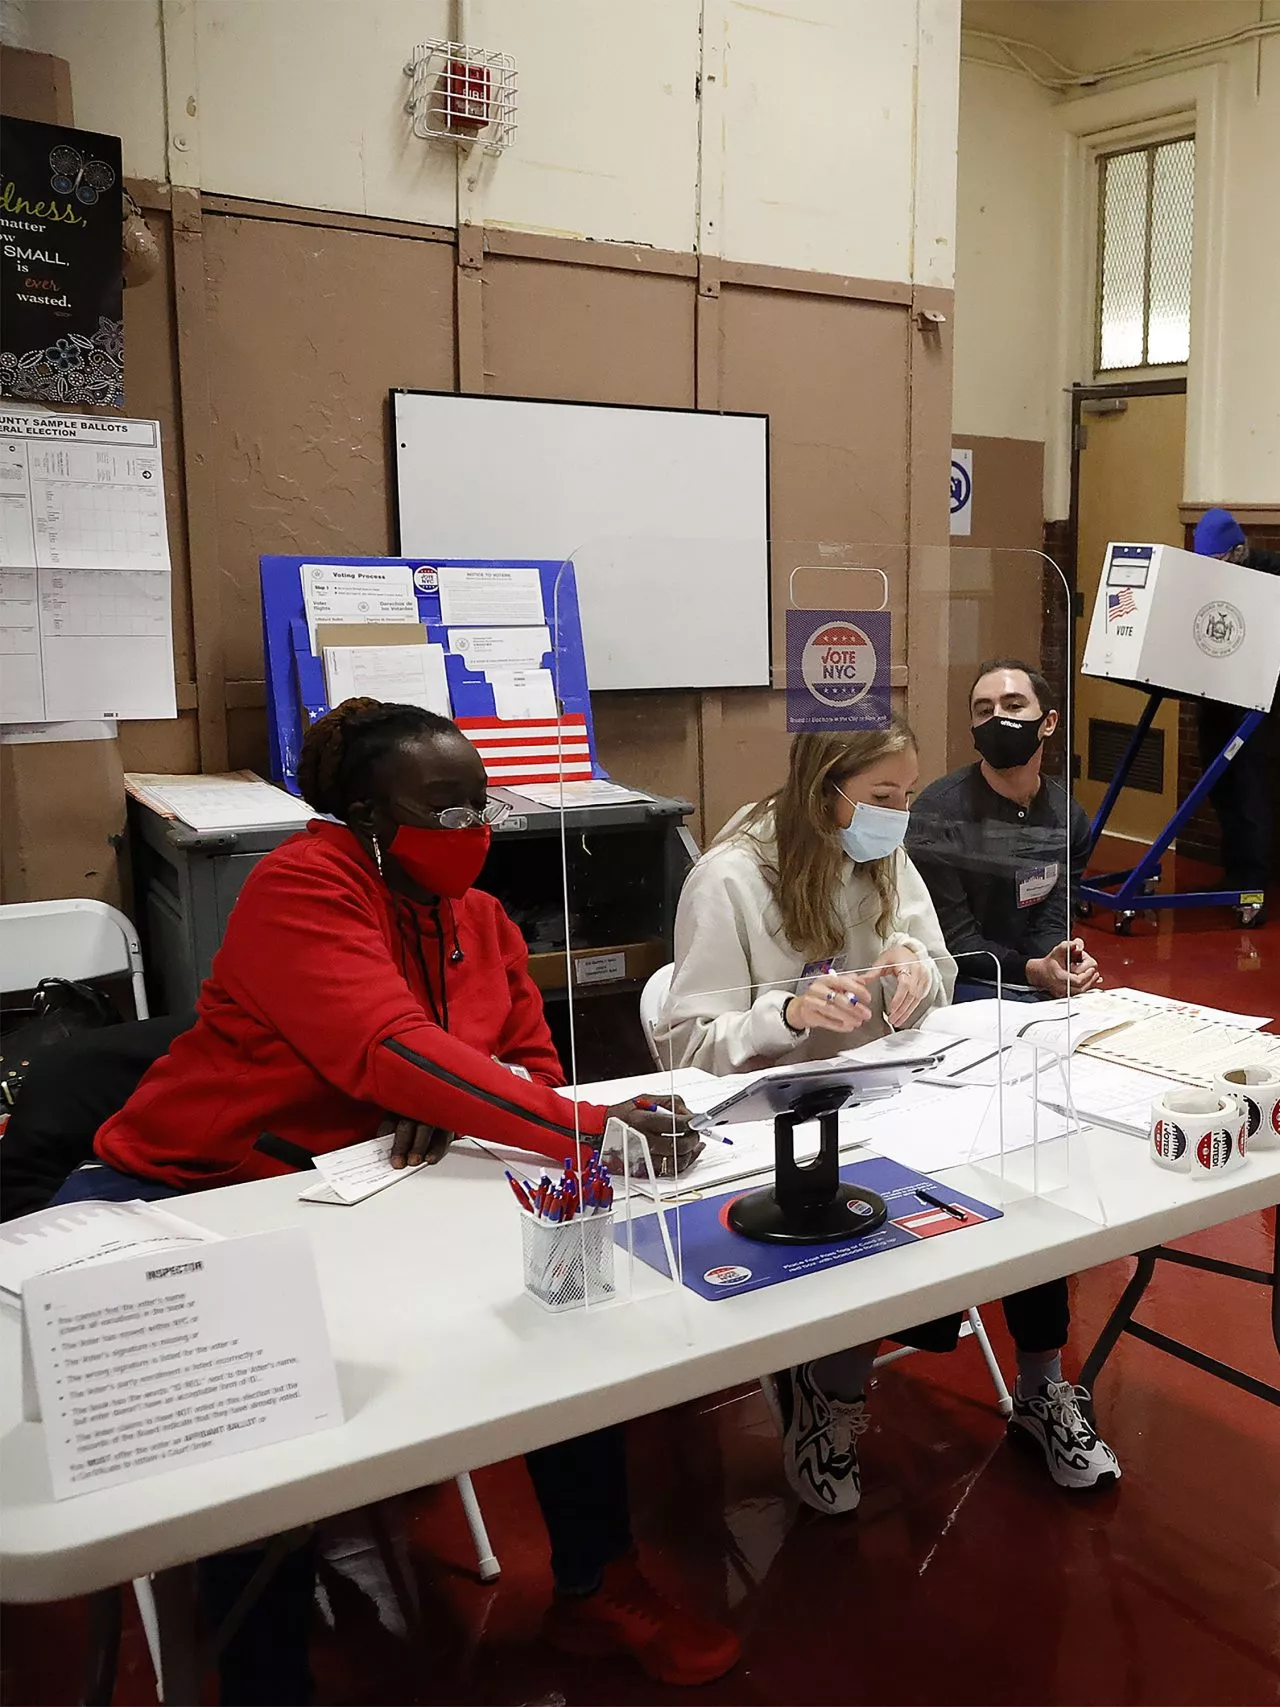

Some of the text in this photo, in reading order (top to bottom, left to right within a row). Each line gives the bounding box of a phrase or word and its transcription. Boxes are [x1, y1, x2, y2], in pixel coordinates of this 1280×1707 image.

[4, 245, 70, 266] SMALL,
[17, 260, 29, 272] is
[25, 278, 60, 291] ever
[16, 293, 72, 307] wasted.
[26, 427, 76, 437] ELECTION
[33, 418, 77, 429] SAMPLE
[80, 422, 128, 433] BALLOTS
[1116, 625, 1134, 637] VOTE
[821, 647, 856, 665] VOTE
[823, 665, 856, 679] NYC
[1212, 1136, 1221, 1168] VOTED!
[146, 1260, 204, 1281] INSPECTOR
